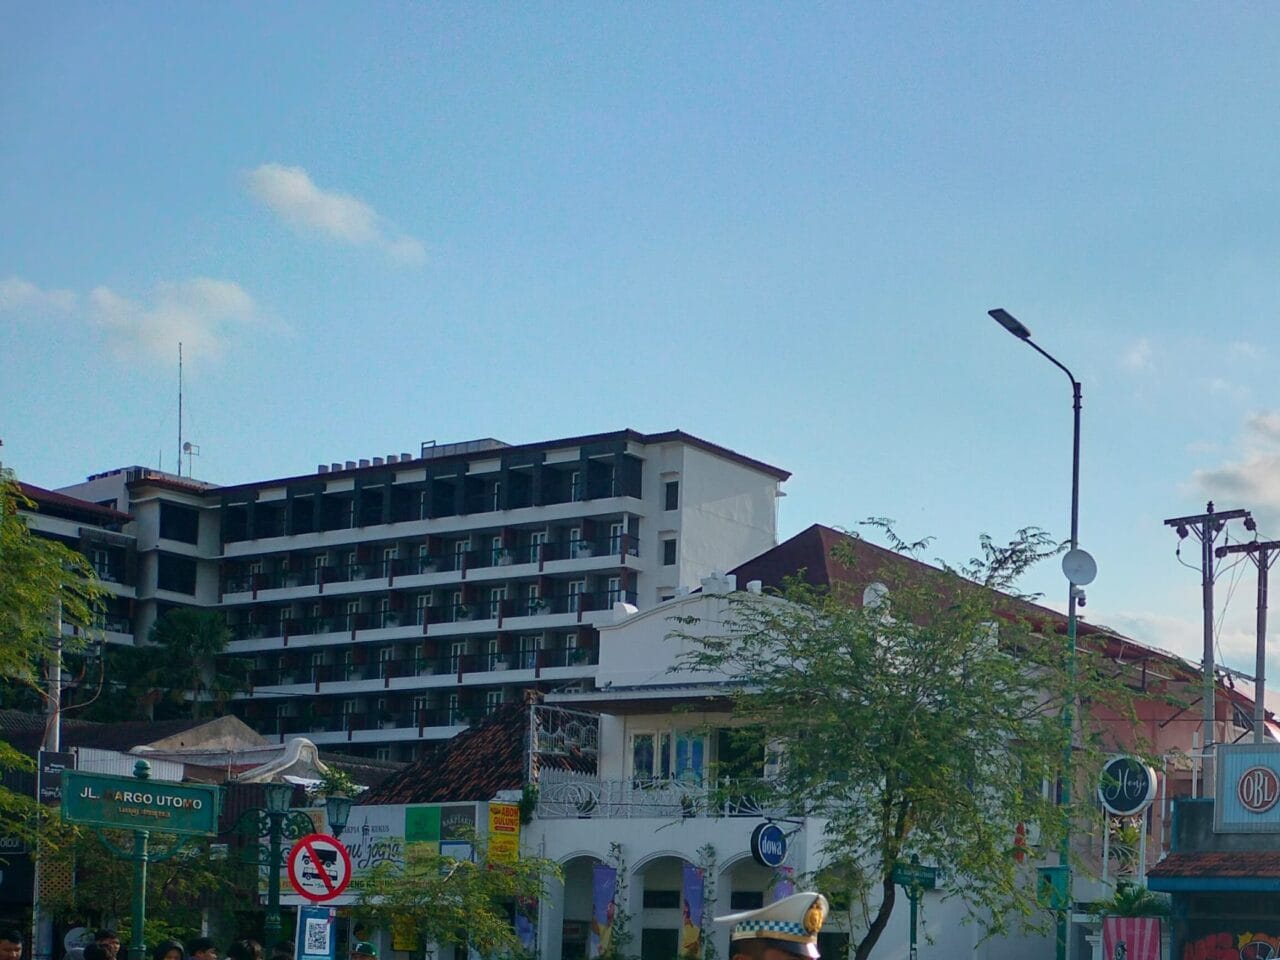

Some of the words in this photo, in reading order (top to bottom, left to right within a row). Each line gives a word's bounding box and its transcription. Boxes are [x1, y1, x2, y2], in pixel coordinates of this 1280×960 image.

[80, 786, 100, 799] JL.
[104, 789, 153, 805] ARGO
[156, 797, 203, 809] UTOMO
[762, 836, 782, 854] dowa
